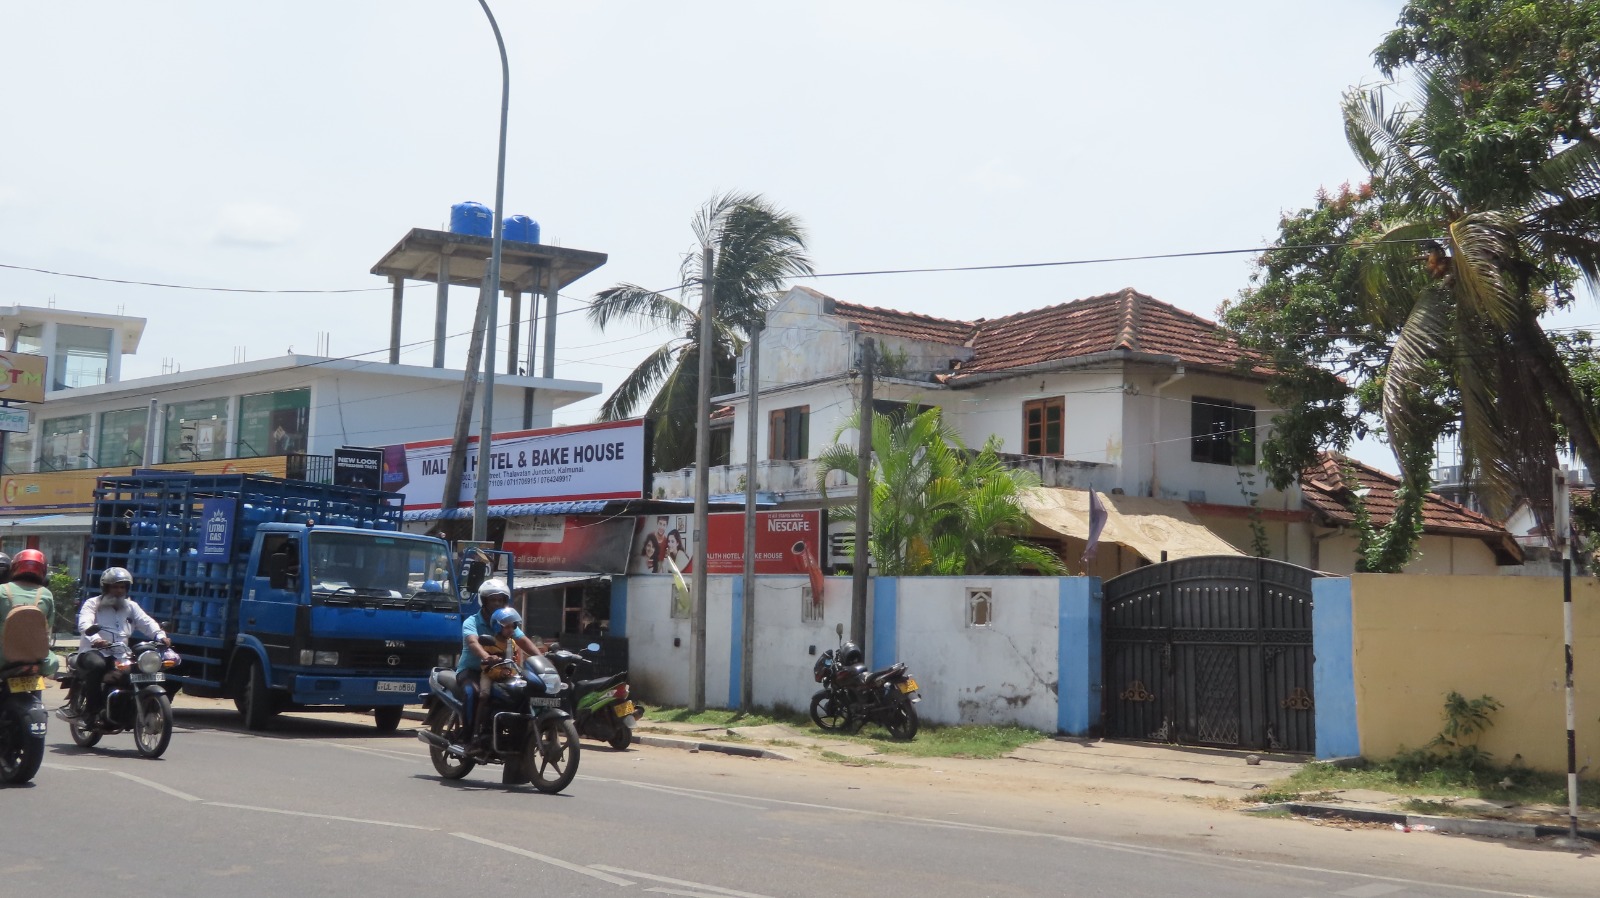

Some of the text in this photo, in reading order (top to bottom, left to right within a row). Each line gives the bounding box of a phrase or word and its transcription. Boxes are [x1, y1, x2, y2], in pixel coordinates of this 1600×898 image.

[422, 442, 624, 476] MAL HTEL & BAKE HOUSE
[532, 468, 557, 476] Junction,
[208, 524, 225, 532] LITRO
[209, 532, 222, 541] GAS
[517, 555, 526, 563] all
[526, 555, 546, 563] starts
